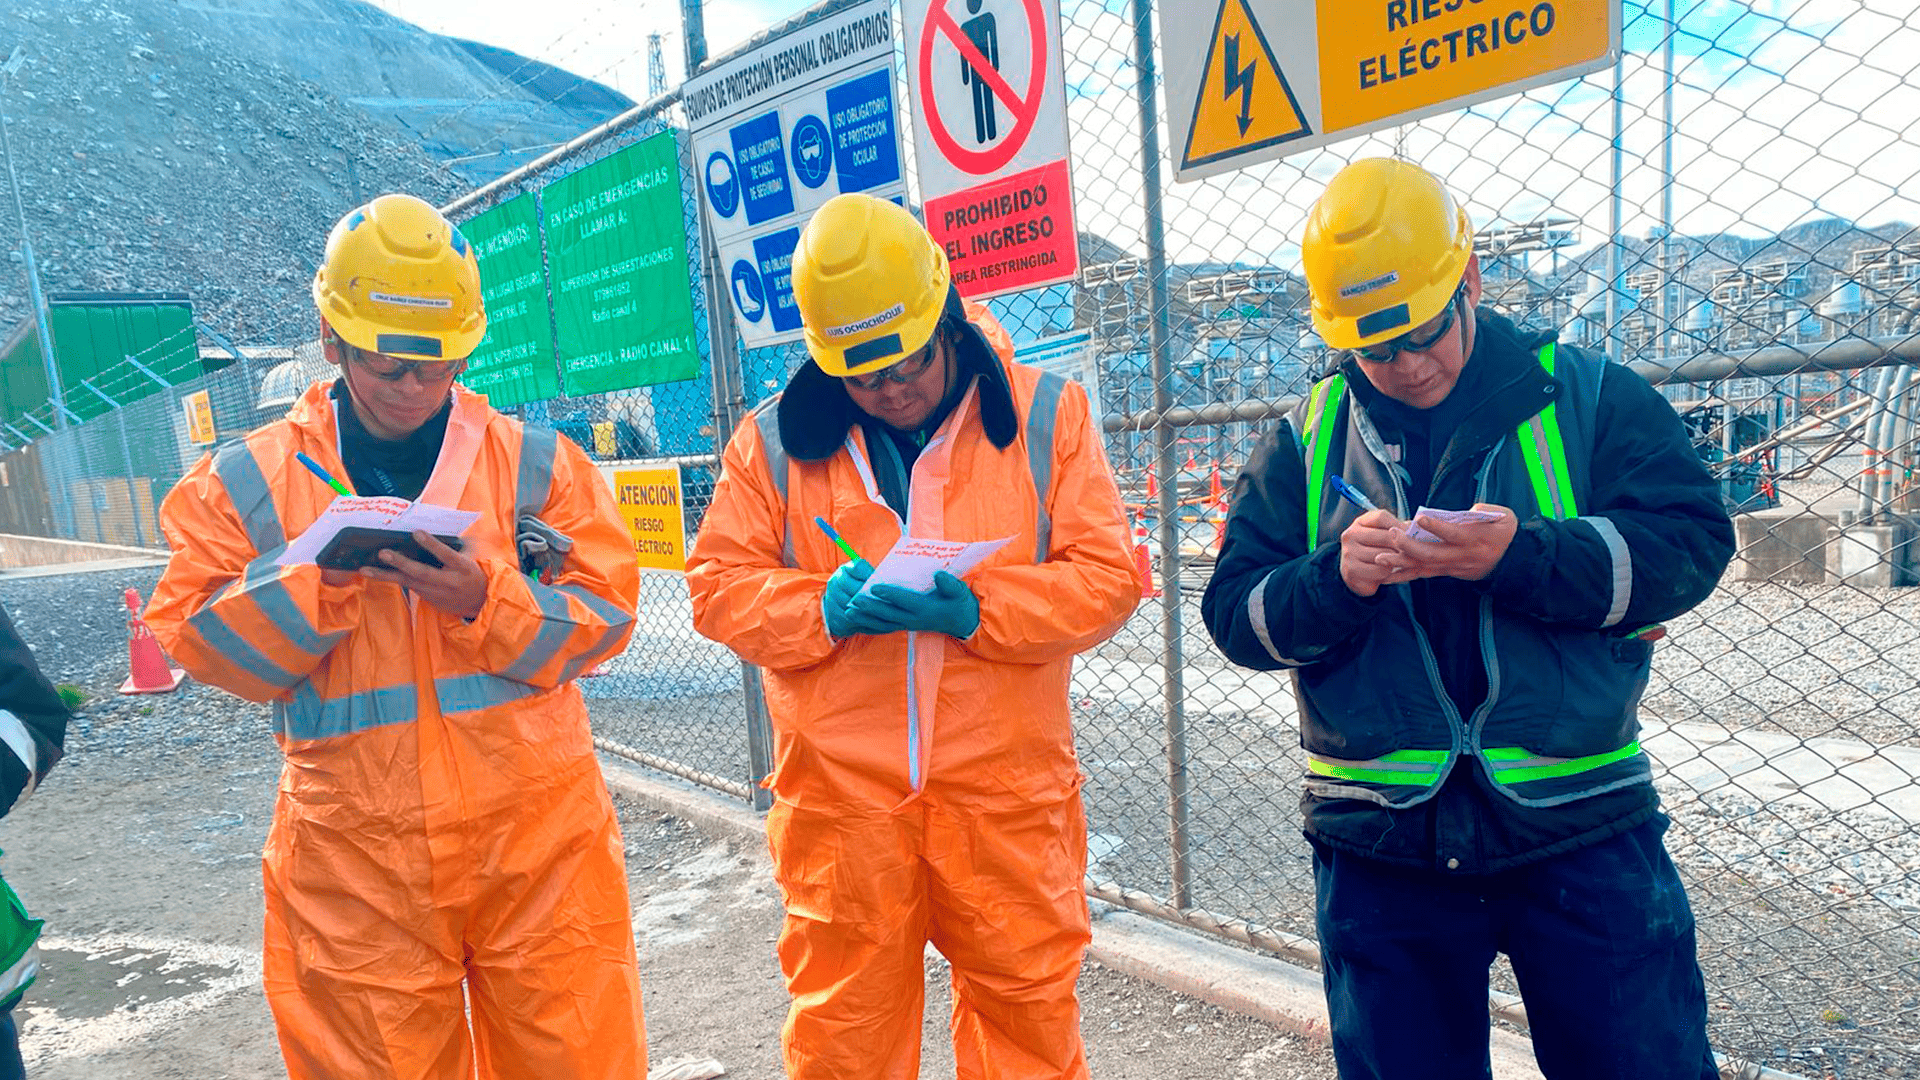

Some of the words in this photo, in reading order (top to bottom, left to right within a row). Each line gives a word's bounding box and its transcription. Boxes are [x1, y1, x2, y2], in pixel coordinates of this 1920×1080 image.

[686, 84, 717, 121] EQUIPOS
[714, 80, 727, 109] DE
[725, 53, 774, 104] PROTECCIÓN
[773, 39, 819, 84] PERSONAL
[819, 10, 889, 65] OBLIGATORIOS
[1359, 2, 1555, 90] ELÉCTRICO
[846, 95, 888, 125] OBLIGATORIO
[852, 145, 878, 167] OCULAR
[550, 211, 562, 228] EN
[562, 201, 585, 223] CASO
[585, 195, 598, 214] DE
[598, 166, 669, 209] EMERGENCIAS
[944, 184, 1048, 232] PROHIBIDO
[580, 213, 616, 240] LLAMAR
[617, 209, 628, 225] A:
[946, 240, 967, 263] EL
[970, 215, 1055, 256] INGRESO
[560, 269, 600, 293] SUPERVISOR
[600, 266, 611, 281] DE
[611, 246, 674, 278] SUBESTACIONES
[980, 250, 1058, 280] RESTRINGIDA
[844, 305, 902, 334] OCHOCHOQUE
[566, 350, 615, 374] EMERGENCIA
[619, 343, 648, 363] RADIO
[649, 337, 683, 358] CANAL
[684, 335, 691, 352] 1
[633, 517, 664, 532] RIESGO
